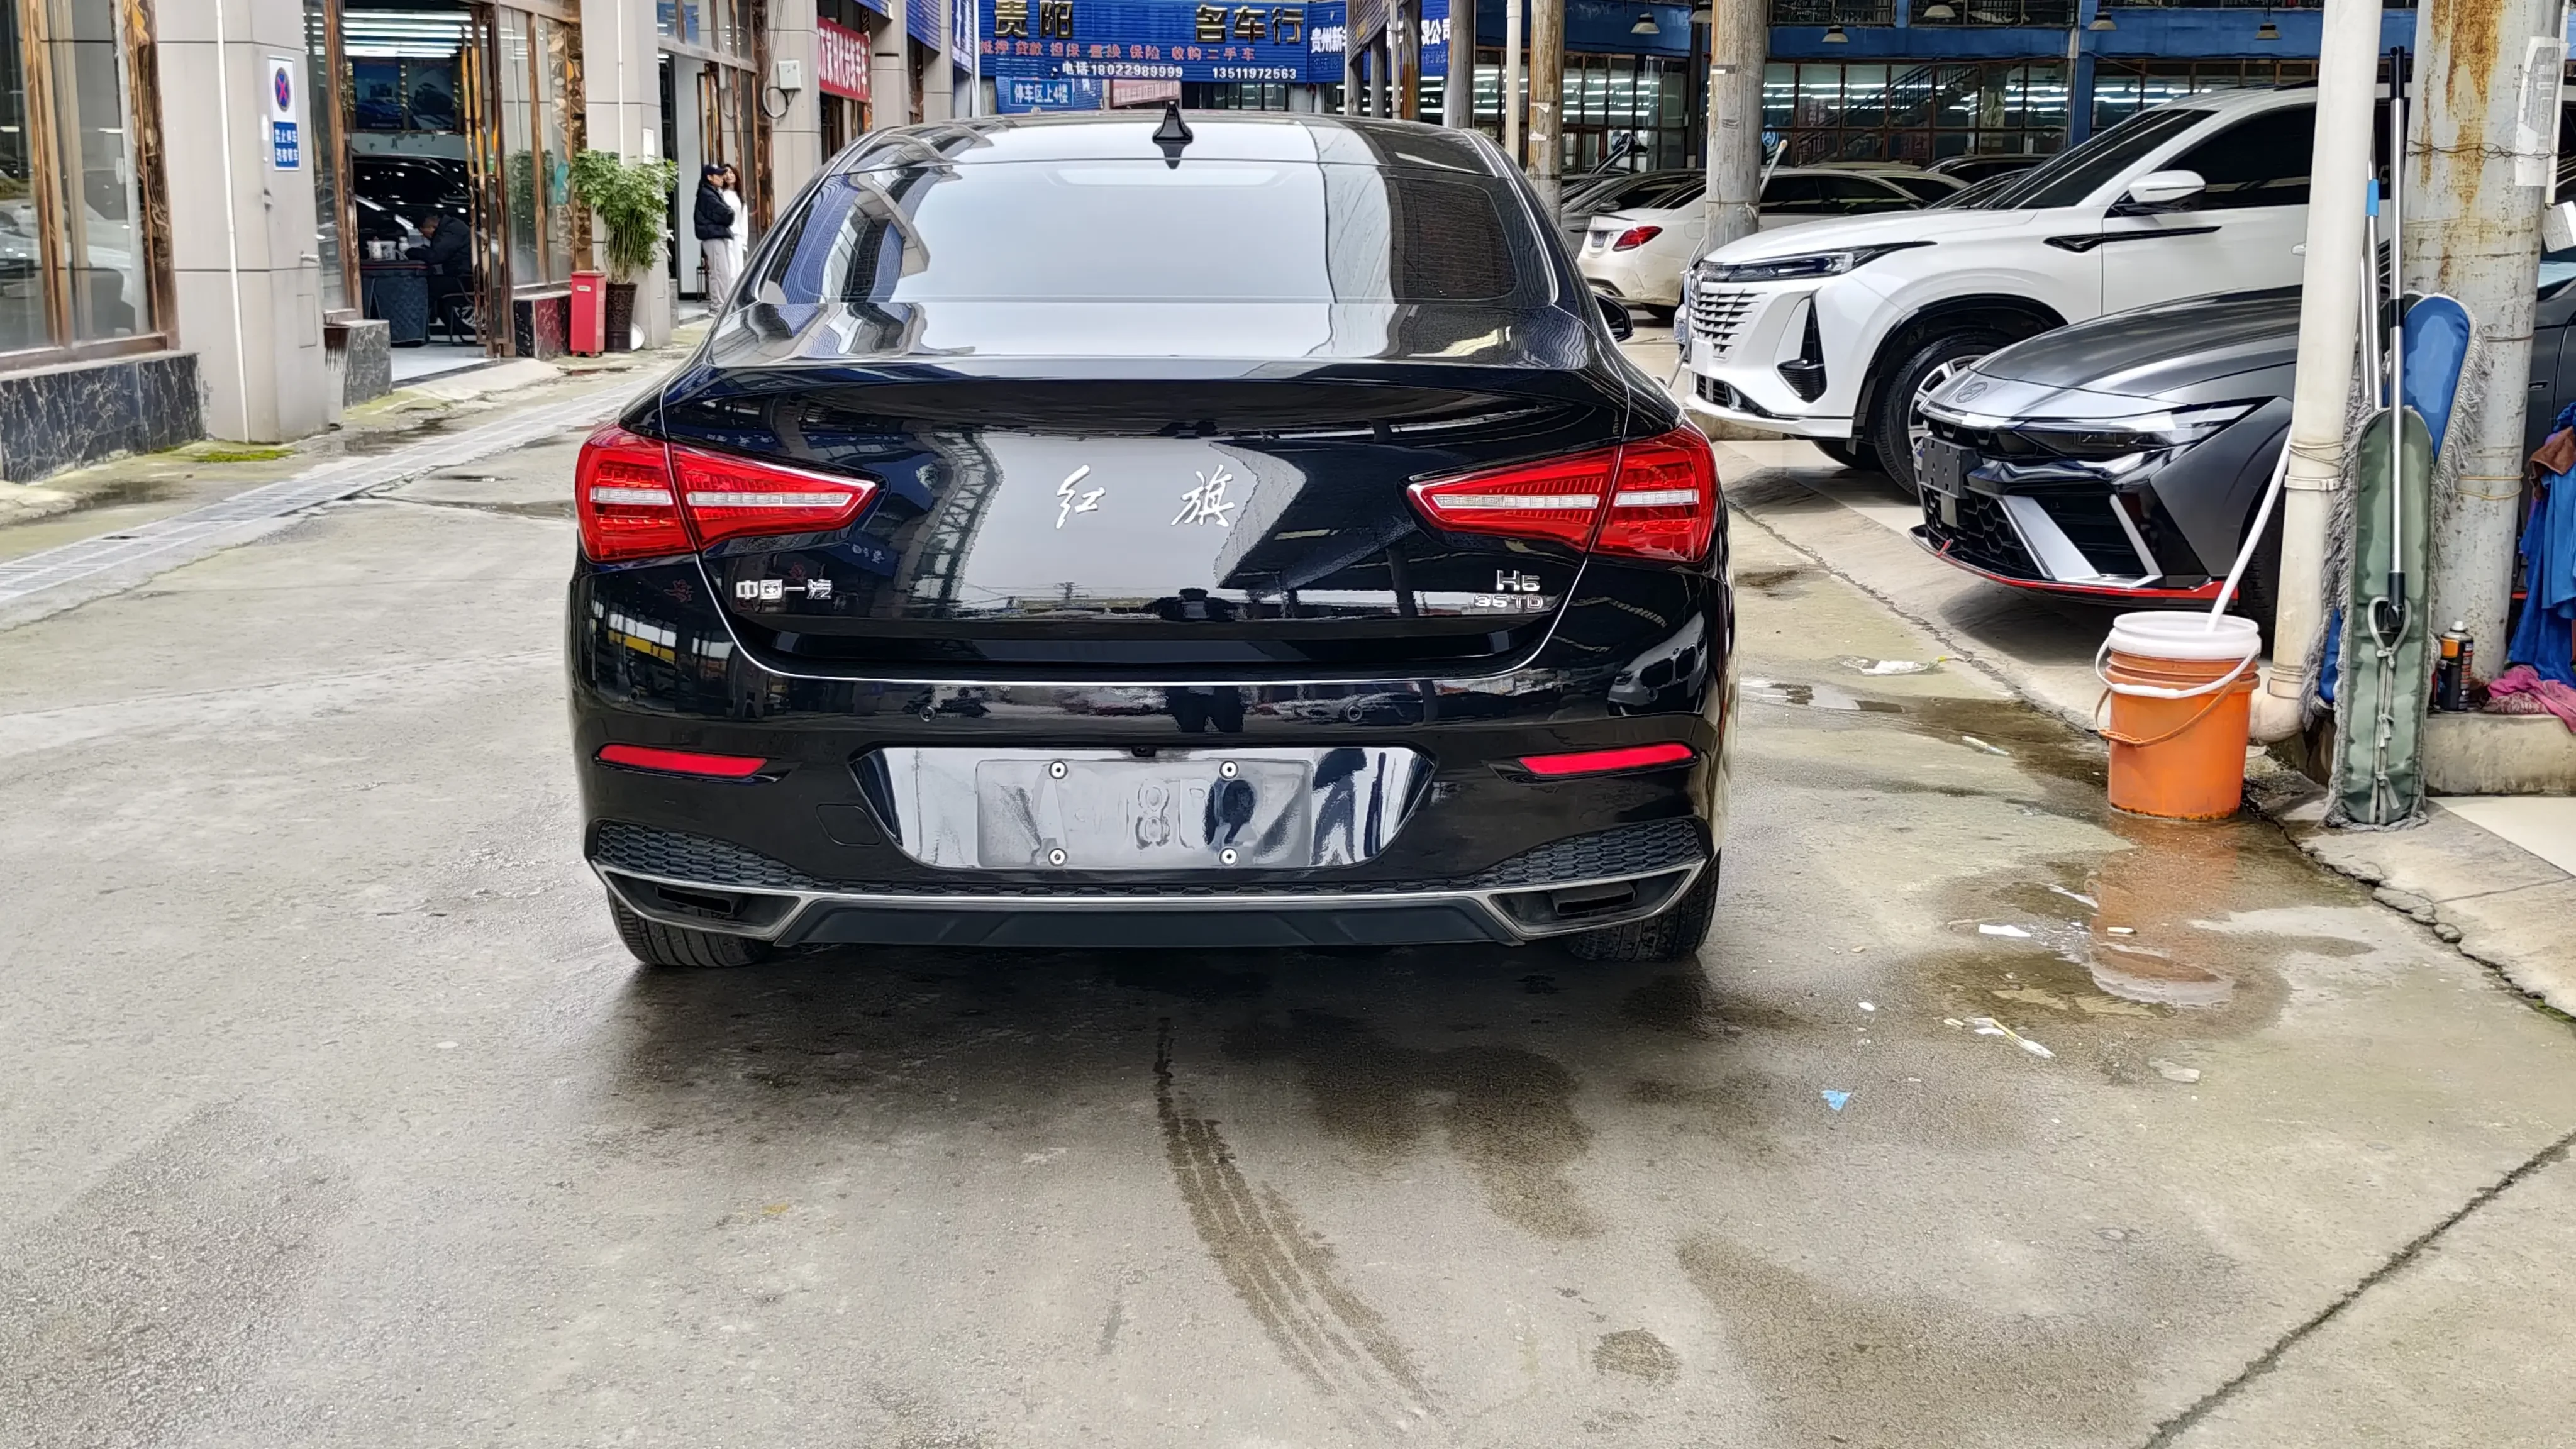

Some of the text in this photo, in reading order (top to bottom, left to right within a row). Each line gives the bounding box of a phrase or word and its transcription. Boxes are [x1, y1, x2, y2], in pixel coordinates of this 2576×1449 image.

[1196, 4, 1304, 43] 名车行
[1212, 67, 1297, 80] 13511972563
[1055, 464, 1235, 530] 红旗
[736, 579, 833, 600] 中国一汽
[1474, 594, 1543, 609] 35TD
